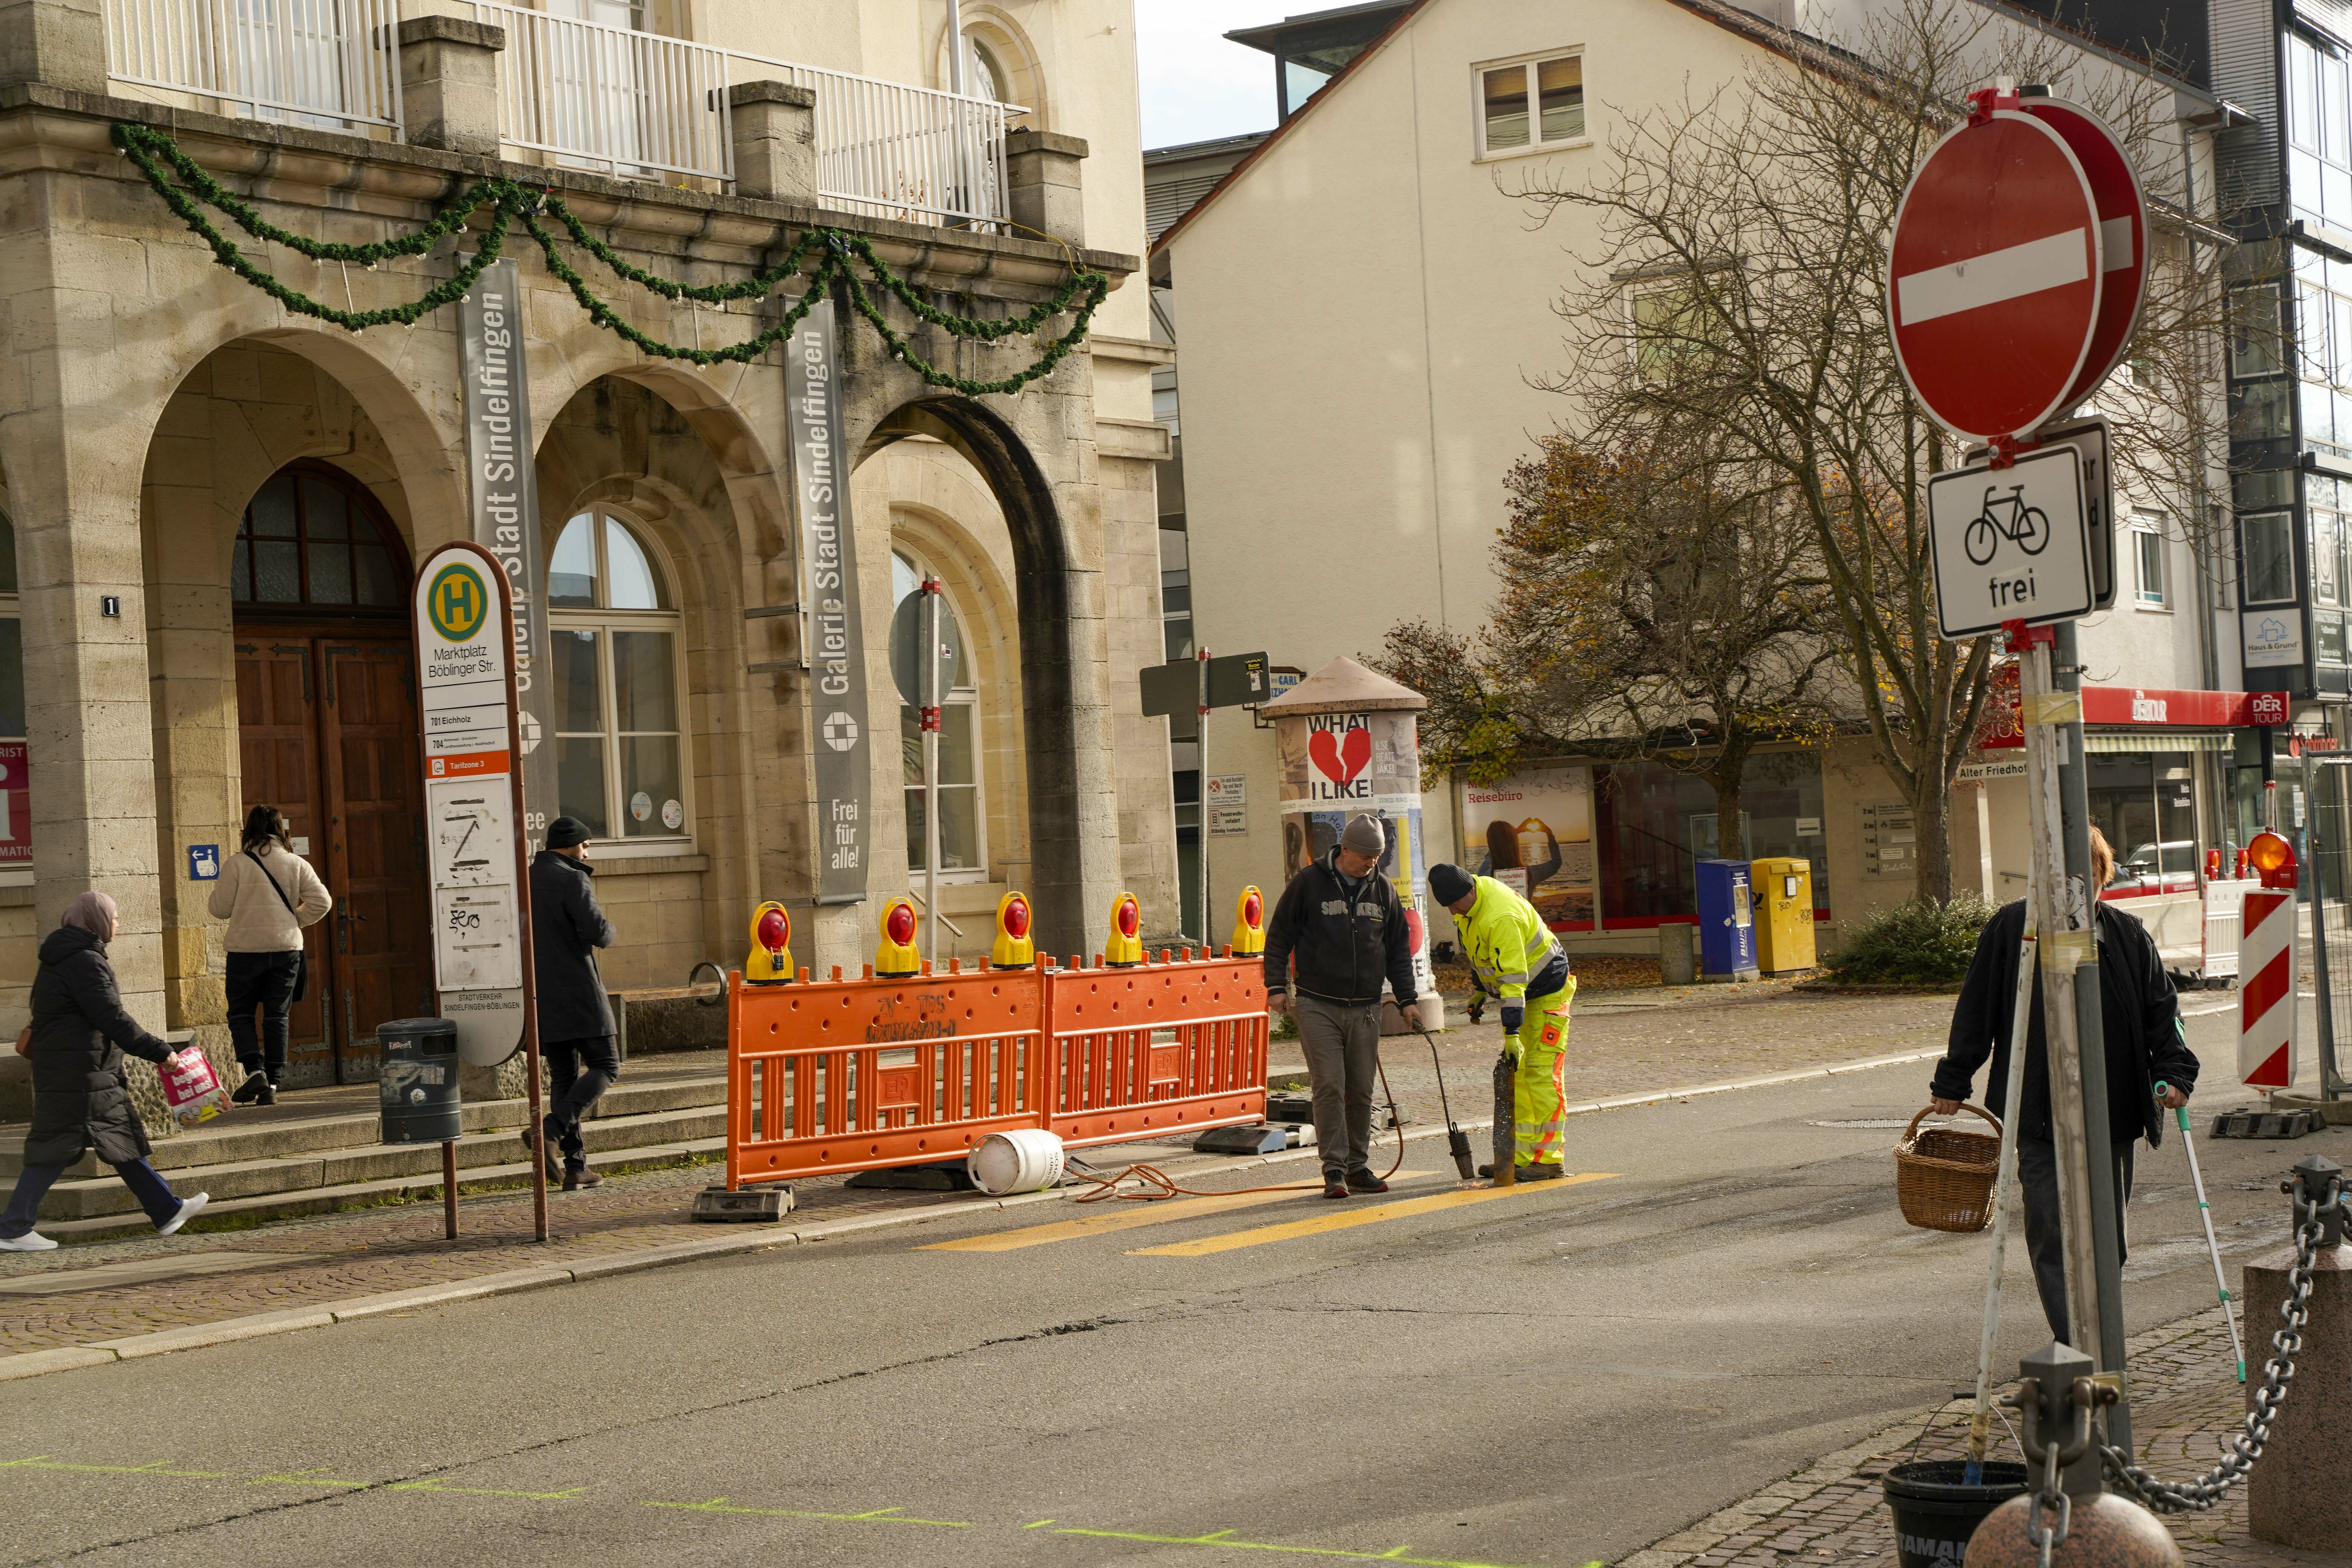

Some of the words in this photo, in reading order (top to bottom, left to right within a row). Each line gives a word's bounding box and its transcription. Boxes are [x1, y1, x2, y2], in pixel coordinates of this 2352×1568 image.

[480, 292, 515, 482] Sindelfingen
[803, 331, 832, 503] Sindelfingen
[815, 512, 839, 589] Stadt
[1989, 568, 2036, 608] frei
[108, 599, 115, 614] 1
[434, 645, 487, 661] Marktplatz
[819, 597, 849, 695] Galerie
[429, 663, 476, 677] Böblinger
[478, 660, 496, 672] Str.
[1279, 675, 1298, 685] CARL
[2252, 699, 2282, 712] DER
[431, 717, 441, 726] 701
[443, 716, 471, 724] Eichholz
[1307, 714, 1370, 735] WHAT
[2252, 713, 2282, 723] TOUR
[433, 740, 443, 749] 704
[1375, 741, 1389, 750] ILSE
[1376, 752, 1396, 762] BEATE
[1960, 768, 1983, 778] Alter
[1986, 763, 2027, 776] Friedhof
[1312, 781, 1316, 800] I
[1321, 778, 1374, 800] LIKE!
[1468, 791, 1522, 803] Reisebüro
[832, 799, 858, 821] Frei
[835, 824, 856, 845] für
[831, 846, 859, 869] alle!
[917, 995, 946, 1014] TBS
[171, 1064, 208, 1086] beginnt
[176, 1085, 195, 1101] bei
[194, 1076, 215, 1094] uns!
